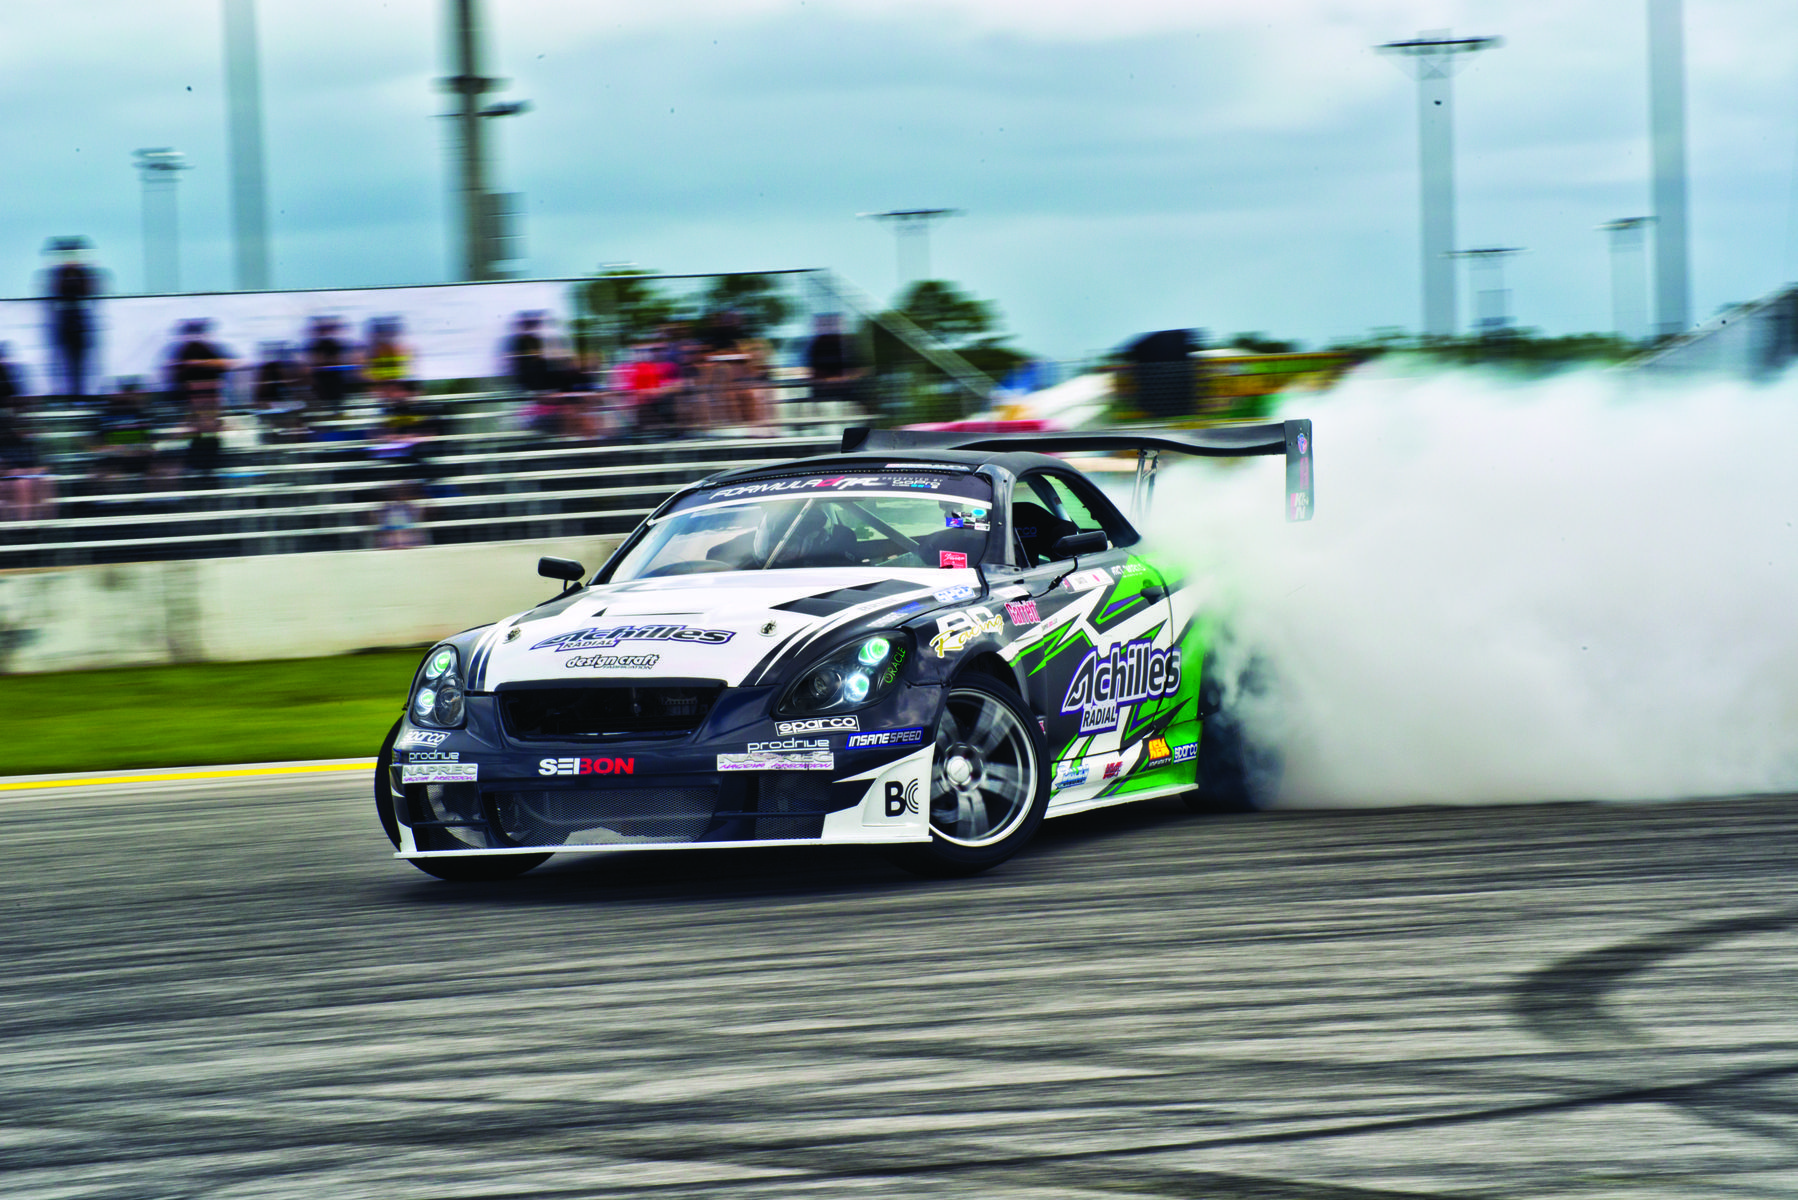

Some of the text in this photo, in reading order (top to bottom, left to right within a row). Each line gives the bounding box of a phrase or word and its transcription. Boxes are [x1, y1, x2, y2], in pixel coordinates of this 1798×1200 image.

[1005, 600, 1041, 625] Garrett
[531, 626, 735, 648] Achilles
[929, 614, 1004, 657] Racing
[563, 639, 614, 649] RADIAL
[565, 654, 660, 669] design craft
[884, 646, 906, 683] ORACLE
[1062, 642, 1180, 712] Achilles
[1083, 705, 1116, 728] RADIAL
[779, 717, 856, 733] sparco
[747, 737, 830, 753] prodrive
[1174, 744, 1198, 759] sparco
[408, 749, 459, 762] prodrive
[403, 765, 477, 776] NAPREC
[538, 758, 634, 775] SEIBON
